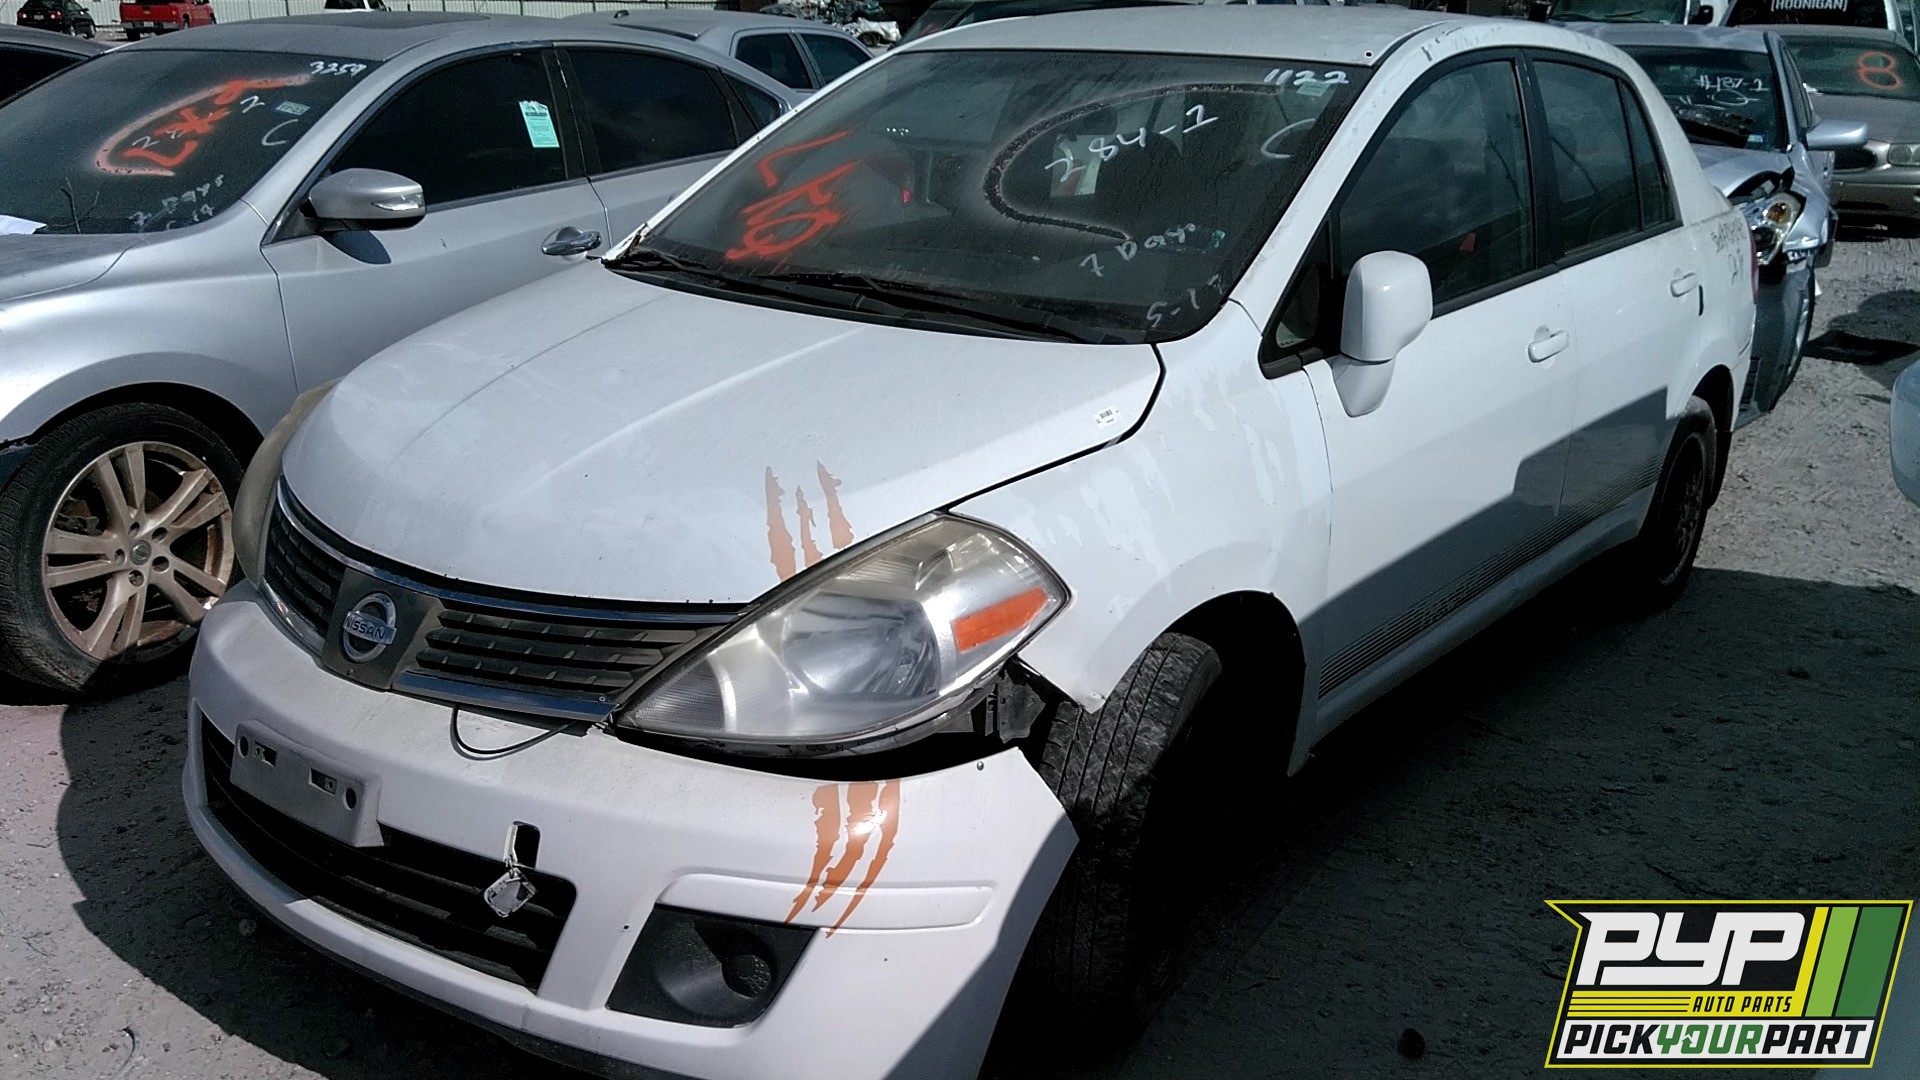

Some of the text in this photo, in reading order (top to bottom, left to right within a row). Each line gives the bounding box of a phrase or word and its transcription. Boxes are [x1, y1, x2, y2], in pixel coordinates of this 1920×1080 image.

[1264, 68, 1349, 86] 1122
[1857, 51, 1902, 90] 8
[345, 616, 386, 640] NISSAN
